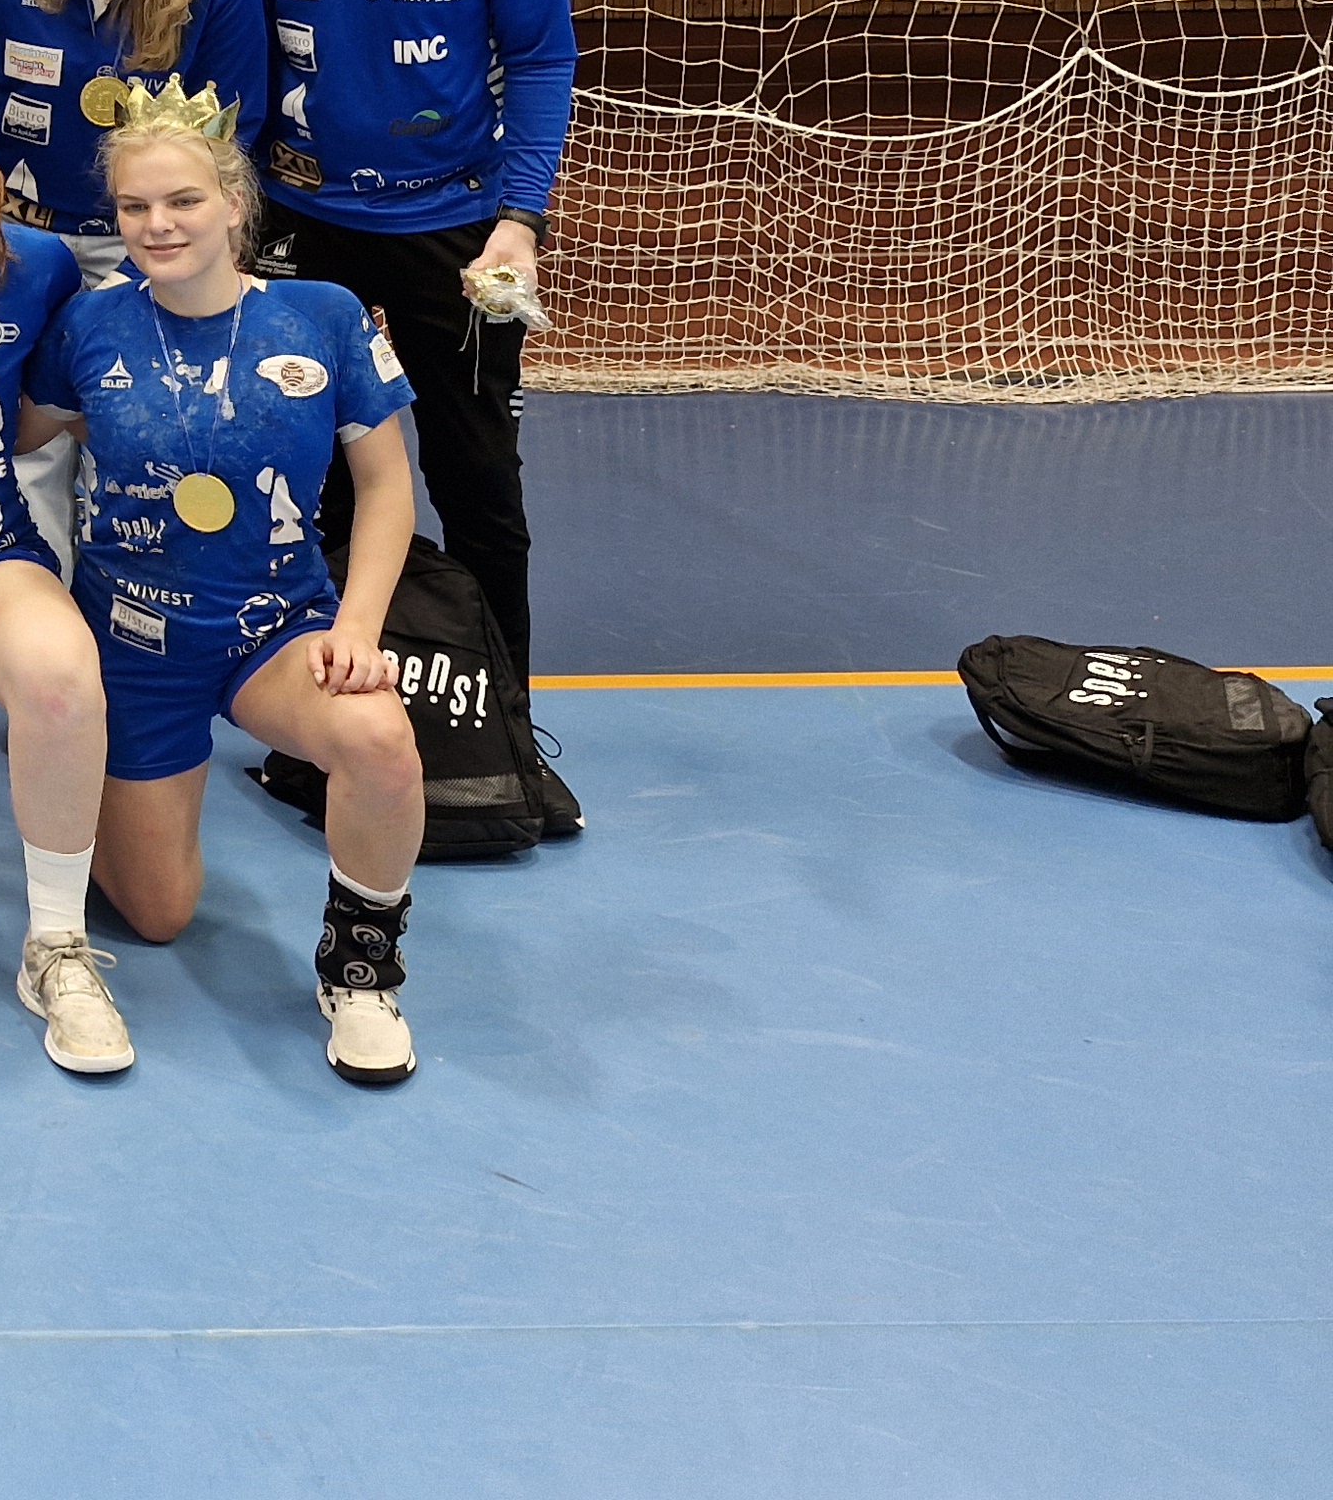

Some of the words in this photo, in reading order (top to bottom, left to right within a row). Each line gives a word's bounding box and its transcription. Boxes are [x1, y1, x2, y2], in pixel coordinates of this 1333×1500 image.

[393, 35, 447, 64] INC
[8, 103, 45, 123] Bistro
[100, 379, 133, 388] SELECT
[117, 604, 159, 635] Bistro
[382, 649, 489, 728] enst
